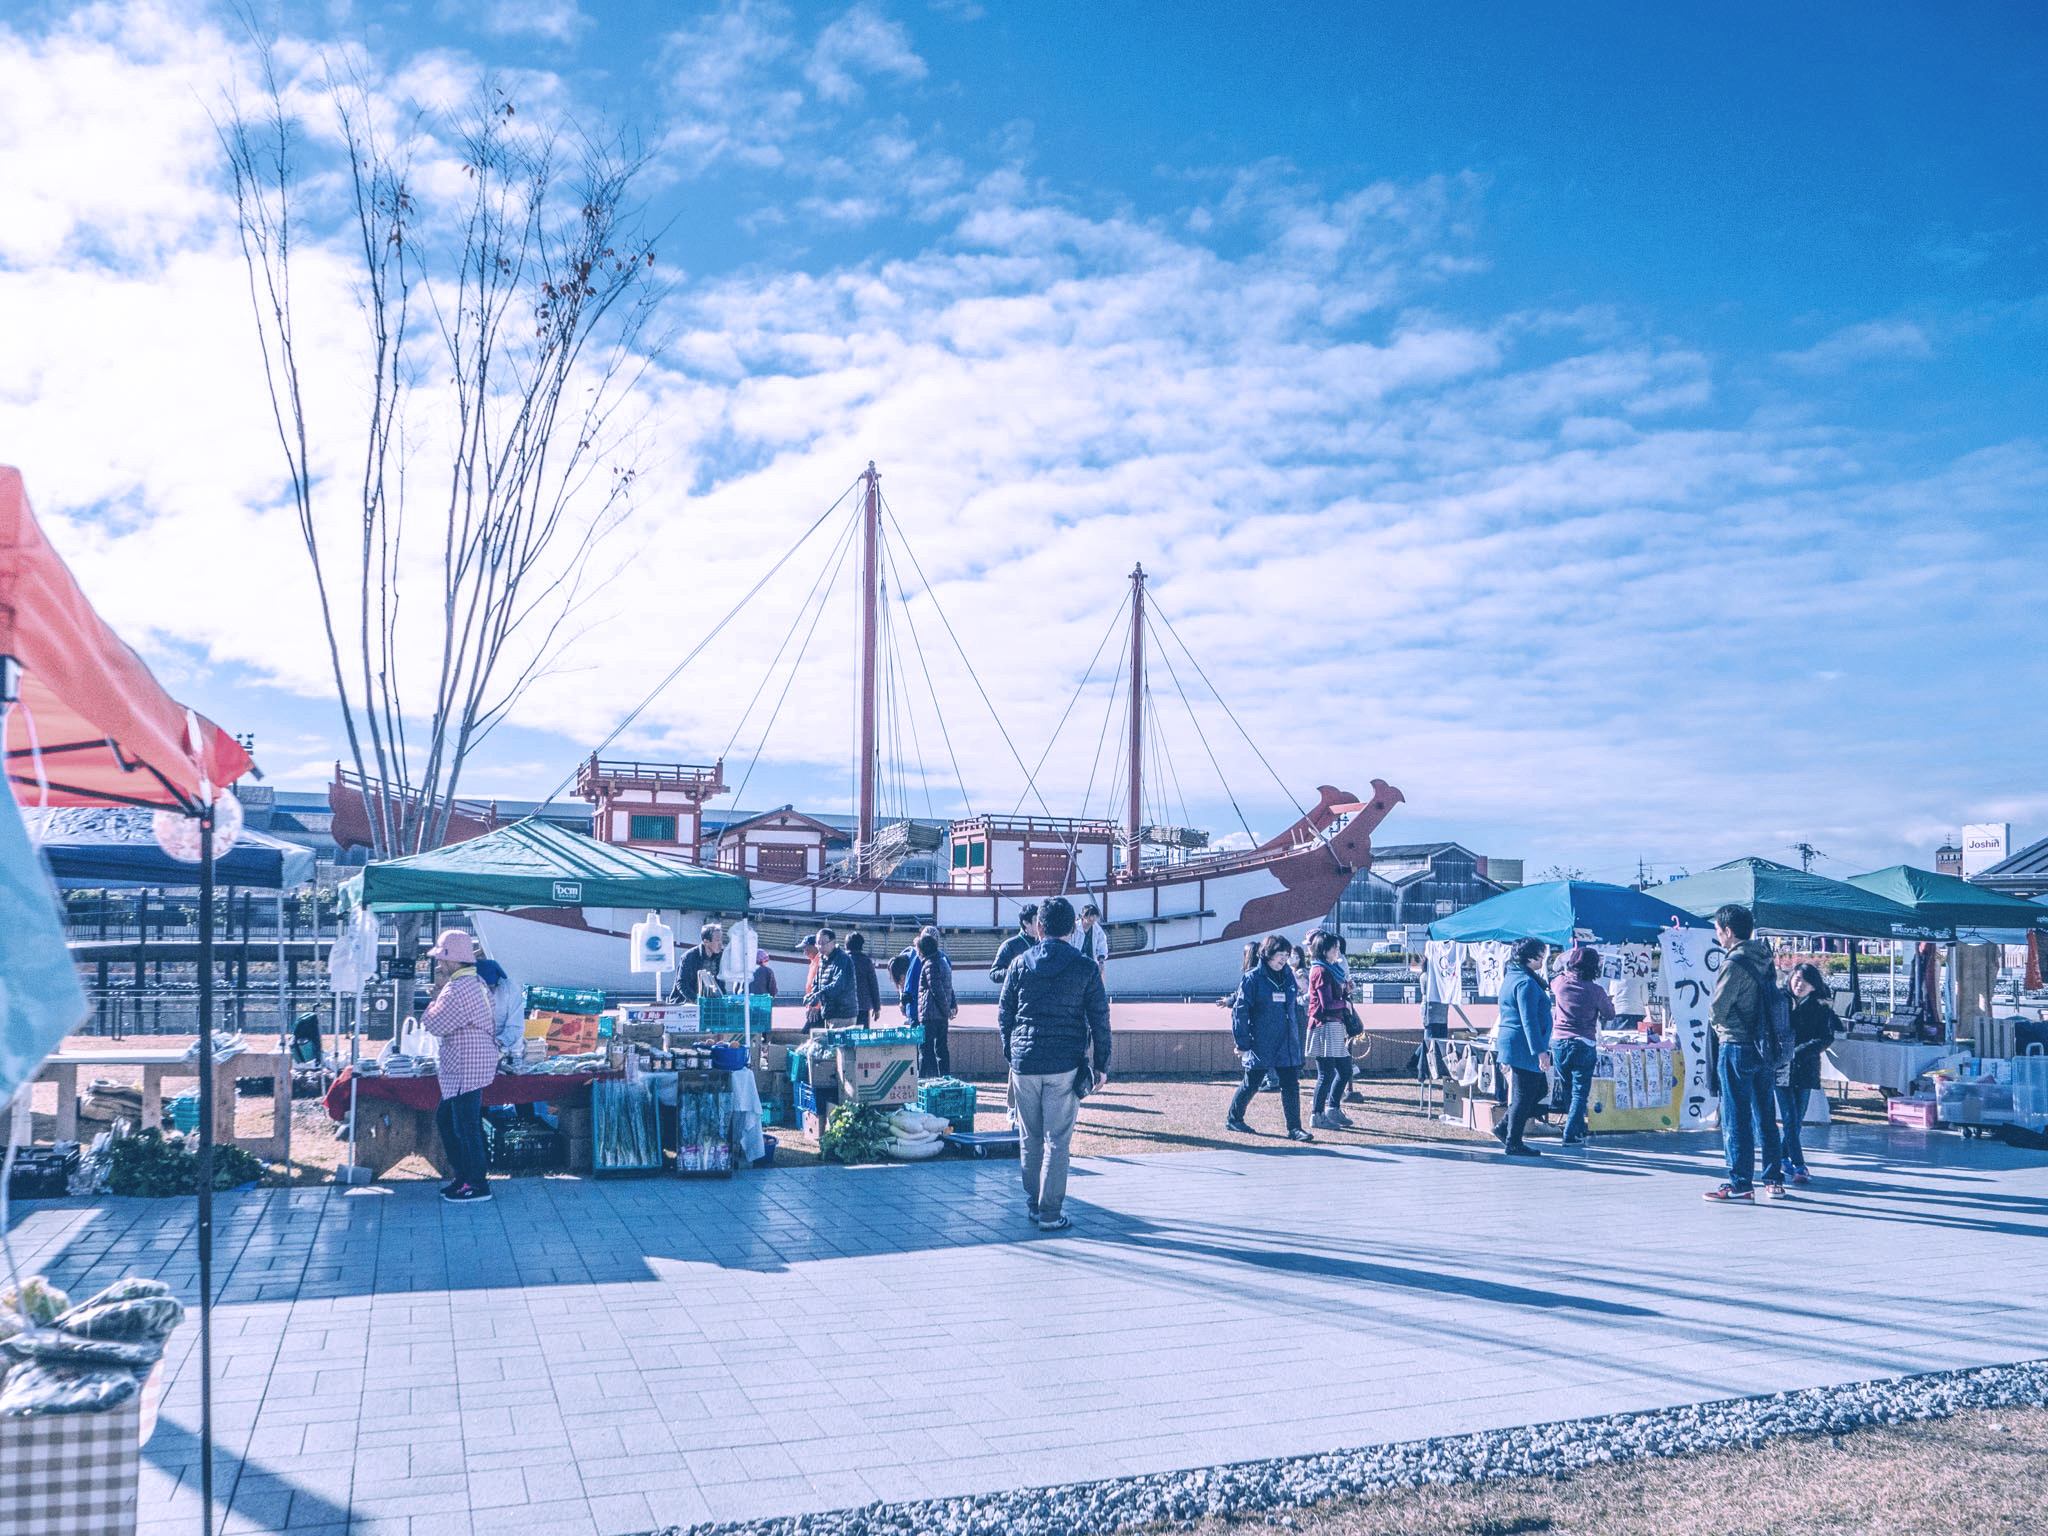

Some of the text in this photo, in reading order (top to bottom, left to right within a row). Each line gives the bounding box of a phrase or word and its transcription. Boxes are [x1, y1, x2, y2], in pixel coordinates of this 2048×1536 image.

[1969, 840, 1999, 848] Joshin
[890, 1090, 915, 1100] はくさい
